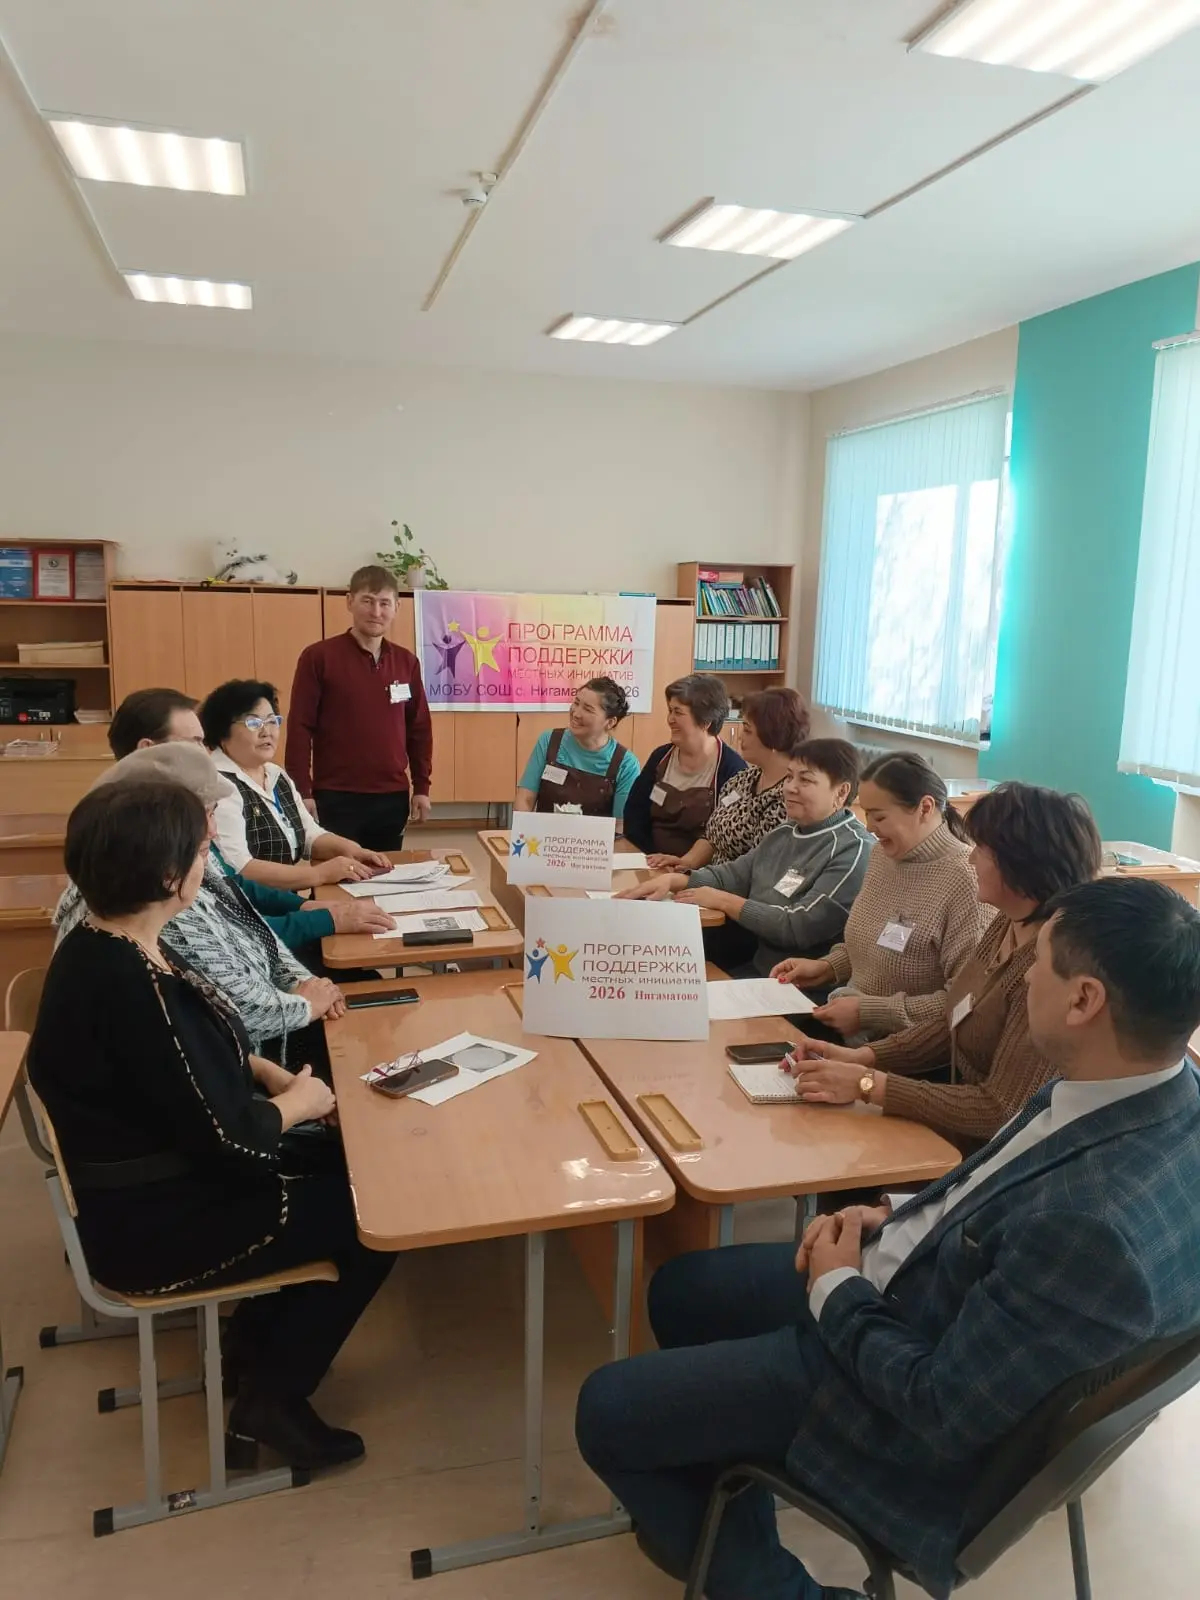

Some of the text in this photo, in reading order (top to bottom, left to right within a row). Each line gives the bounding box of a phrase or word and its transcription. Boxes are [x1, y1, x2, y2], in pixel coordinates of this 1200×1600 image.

[508, 622, 633, 642] ПРОГРАММА
[508, 646, 633, 667] ПОДДЕРЖКИ
[429, 683, 473, 697] МОБУ
[476, 683, 511, 697] СОШ
[530, 685, 578, 697] Нигама
[544, 836, 606, 847] ПРОГРАММА
[543, 845, 608, 856] ПОДДЕРЖКИ
[546, 859, 566, 867] 2026
[583, 943, 692, 957] ПРОГРАММА
[582, 960, 698, 975] ПОДДЕРЖКИ
[589, 986, 625, 1000] 2026
